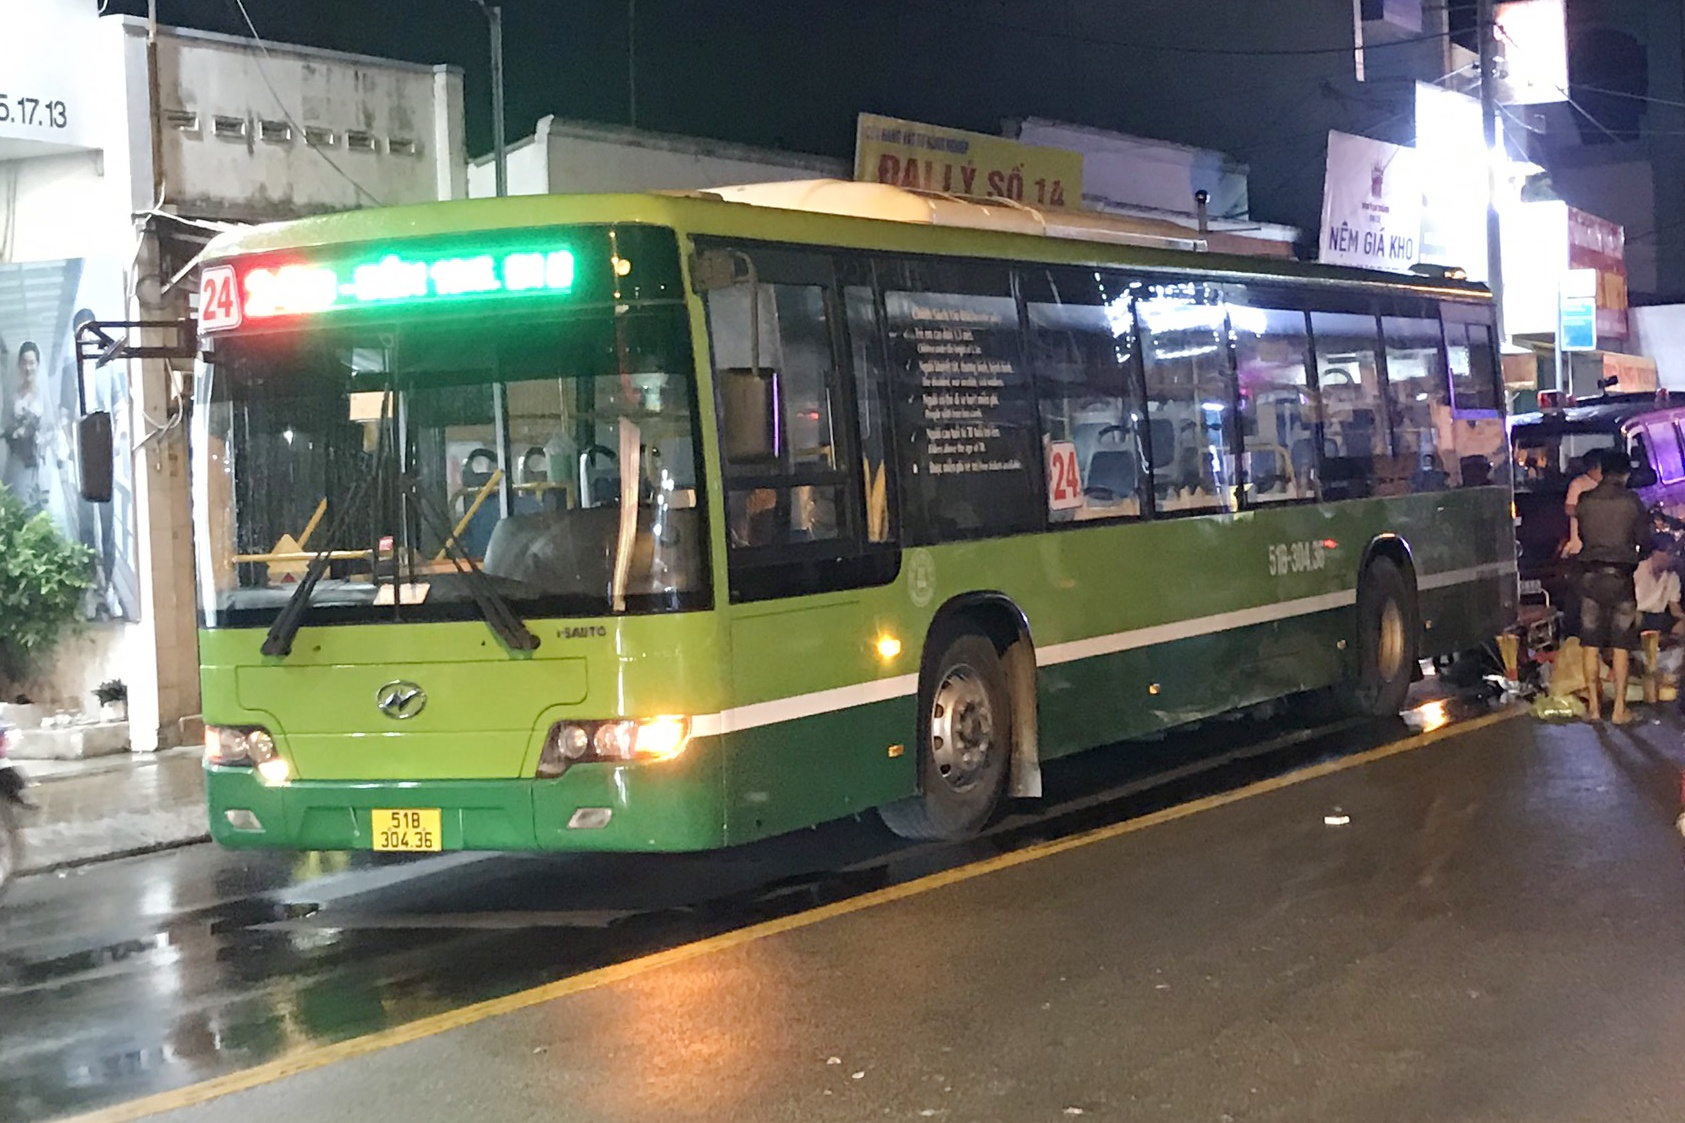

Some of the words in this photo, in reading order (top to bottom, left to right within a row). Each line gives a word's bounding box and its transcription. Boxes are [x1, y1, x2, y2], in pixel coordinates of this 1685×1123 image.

[1329, 220, 1359, 258] NỆM
[1363, 227, 1386, 258] GIÁ
[203, 276, 233, 321] 24
[1052, 451, 1079, 501] 24
[391, 812, 421, 829] 51B
[380, 831, 433, 849] 304.36
